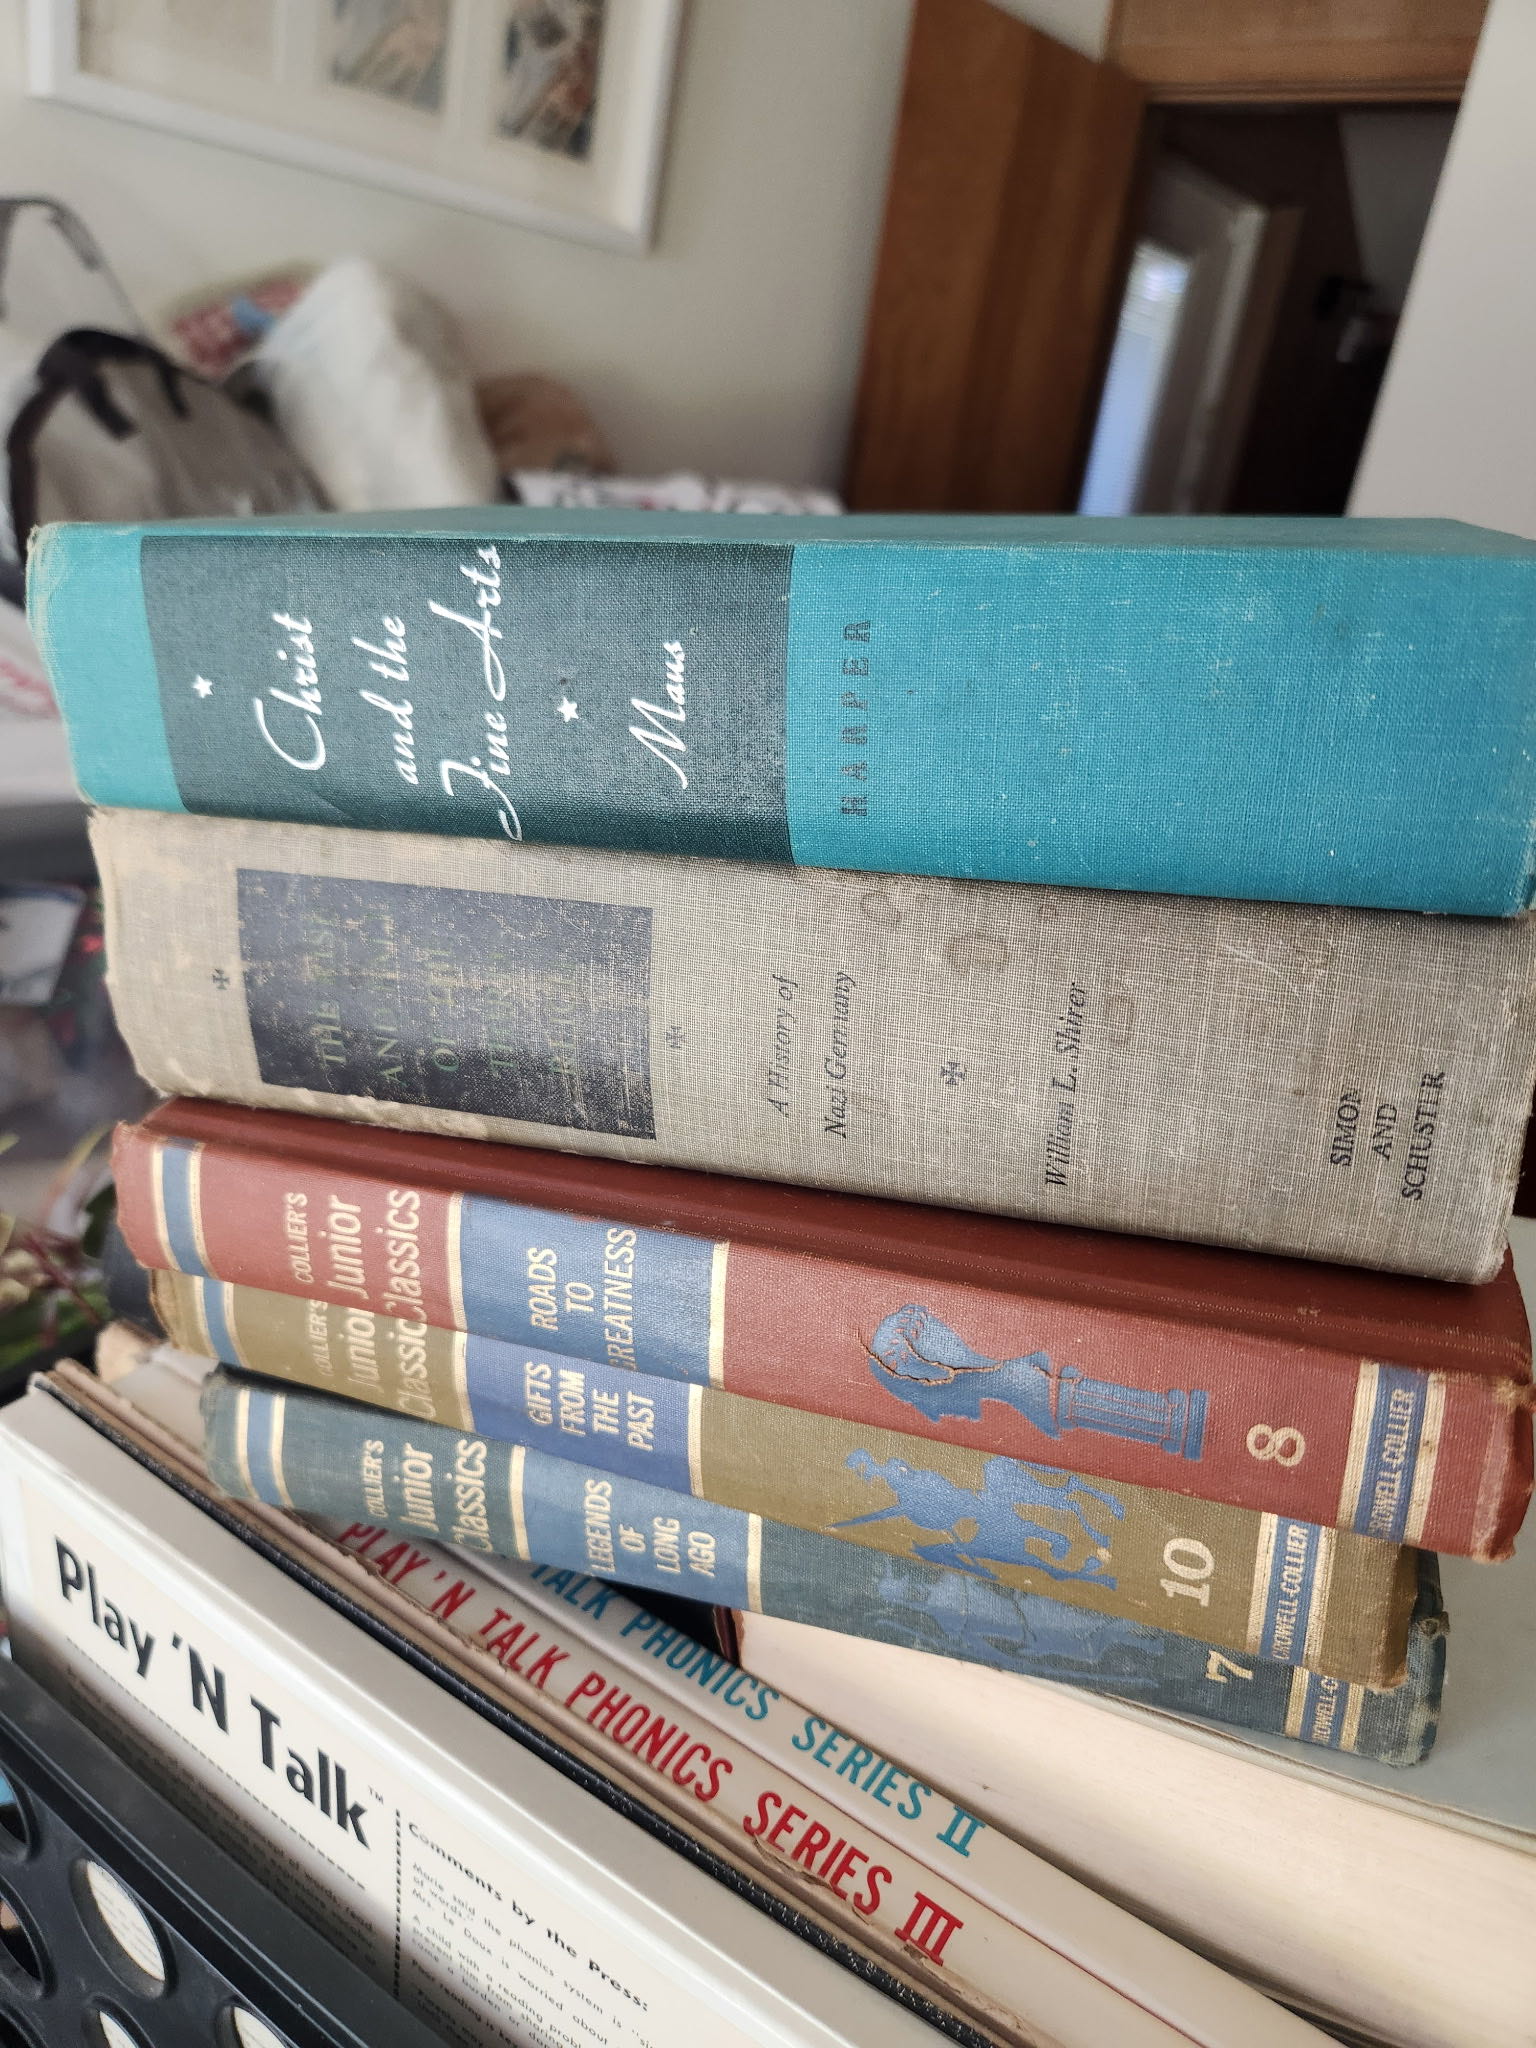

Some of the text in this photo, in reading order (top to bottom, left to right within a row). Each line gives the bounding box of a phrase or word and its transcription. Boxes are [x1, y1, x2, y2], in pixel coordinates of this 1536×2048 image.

[253, 611, 326, 771] Christ
[351, 614, 419, 785] and the
[428, 544, 523, 842] Fine Arts
[628, 640, 688, 790] Maus
[841, 618, 872, 818] HARPER
[767, 974, 799, 1118] A History of
[824, 972, 856, 1139] Nazi Germany
[1045, 982, 1087, 1187] William L. Shirer
[1330, 1084, 1361, 1167] SIMON
[1372, 1103, 1398, 1161] AND
[1402, 1072, 1446, 1201] SCHUSTER
[286, 1192, 315, 1284] COLLIER'S
[318, 1194, 370, 1300] Junior
[528, 1247, 559, 1331] ROADS
[564, 1281, 595, 1314] TO
[388, 1317, 437, 1420] Classic
[525, 1361, 554, 1427] GIFTS
[558, 1368, 587, 1438] FROM
[592, 1388, 620, 1435] THE
[626, 1390, 656, 1453] PAST
[1246, 1423, 1306, 1468] 8
[393, 1442, 440, 1533] Junior
[583, 1478, 616, 1574] LEGENDS
[618, 1522, 647, 1554] OF
[653, 1516, 682, 1575] LONG
[687, 1530, 717, 1578] AGO
[1160, 1537, 1216, 1608] 10
[1271, 1524, 1310, 1661] CROWELL-COLLIER
[55, 1535, 156, 1680] Play
[171, 1631, 230, 1735] 'N
[249, 1694, 371, 1851] Talk
[1205, 1649, 1253, 1684] 7
[618, 1605, 781, 1722] PHONICS
[791, 1715, 933, 1821] SERIES
[936, 1804, 987, 1858] II
[477, 1606, 571, 1690] TALK
[562, 1670, 734, 1802] PHONICS
[742, 1790, 894, 1917] SERIES
[894, 1890, 964, 1967] III
[408, 1822, 504, 1901] Comments
[512, 1899, 536, 1925] by
[546, 1927, 578, 1958] the
[427, 1926, 451, 1950] child
[458, 1951, 480, 1972] with
[486, 1973, 493, 1982] a
[499, 1983, 543, 2023] reading
[440, 1984, 482, 2022] reading
[447, 1966, 454, 1976] a
[462, 1976, 501, 2012] burden
[508, 2015, 520, 2028] or
[453, 1893, 475, 1916] said
[484, 1917, 502, 1935] the
[509, 1938, 555, 1977] phonics
[563, 1979, 604, 2014] system
[612, 2016, 622, 2029] is
[459, 1962, 479, 1982] him
[487, 1983, 513, 2010] from
[501, 1957, 510, 1969] is
[518, 1972, 563, 2011] worried
[572, 2014, 608, 2046] about
